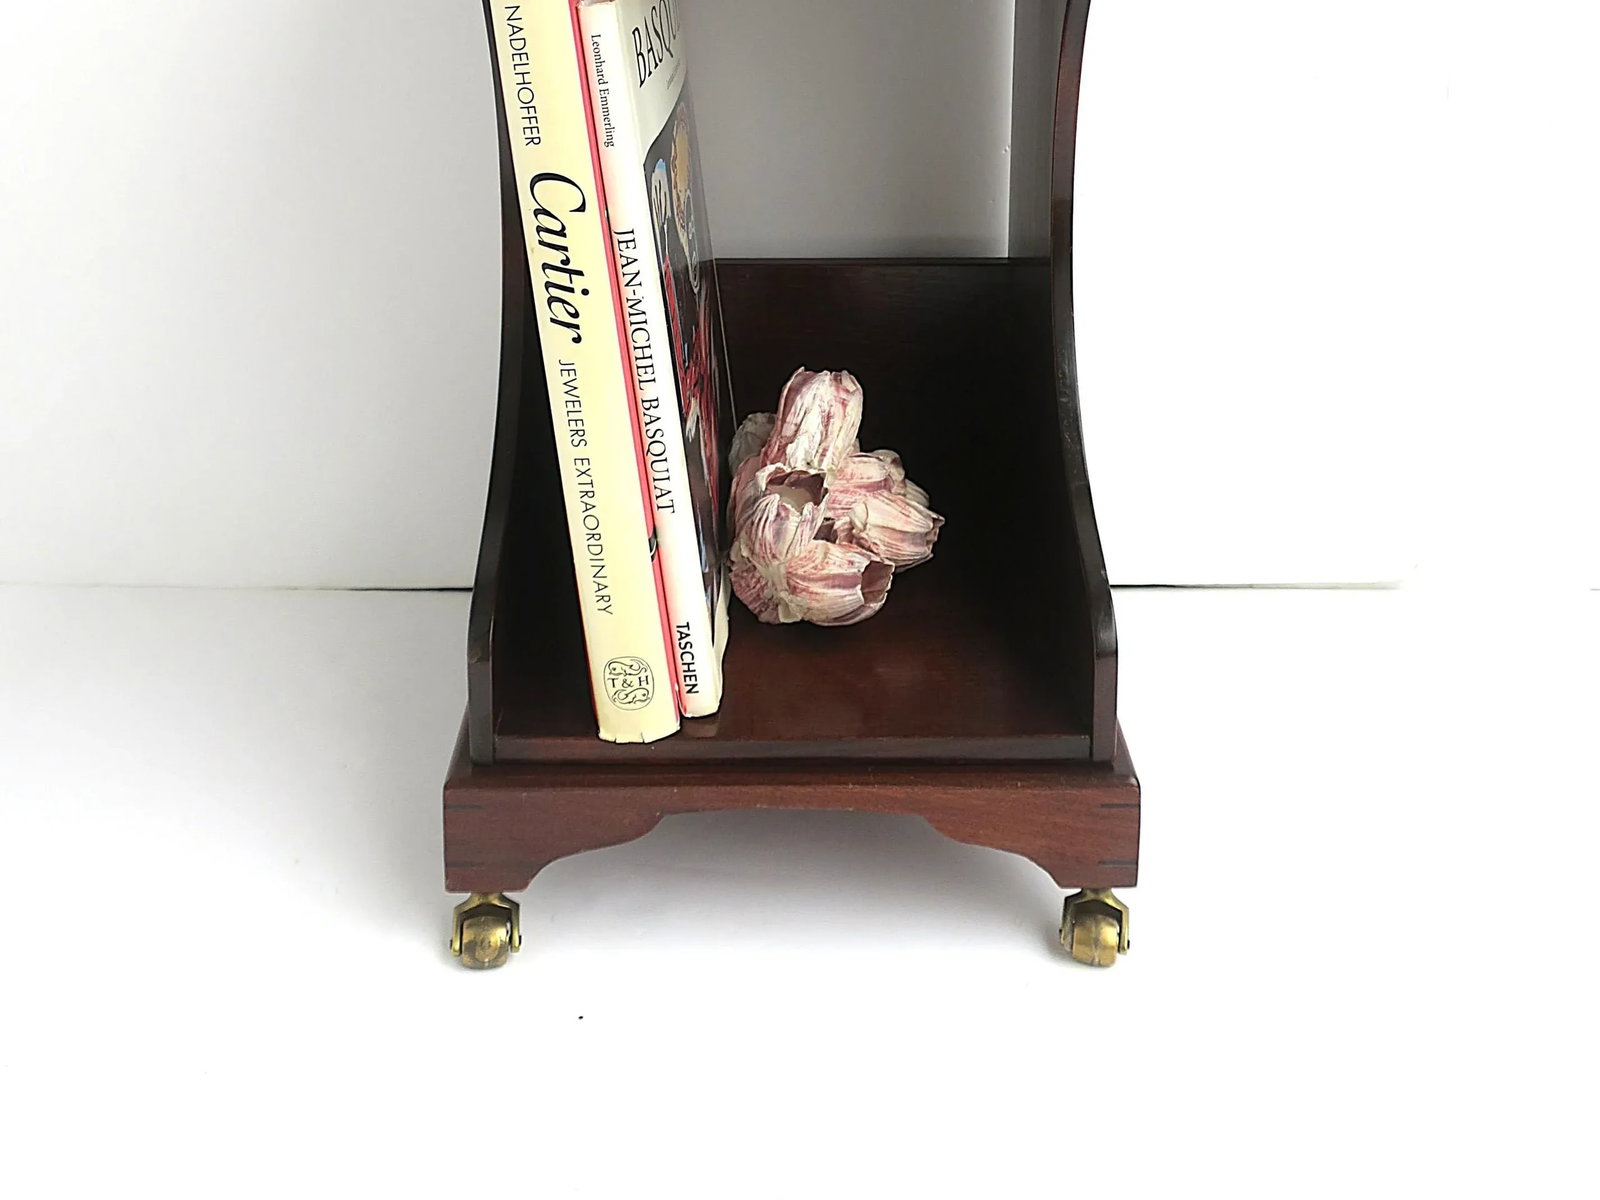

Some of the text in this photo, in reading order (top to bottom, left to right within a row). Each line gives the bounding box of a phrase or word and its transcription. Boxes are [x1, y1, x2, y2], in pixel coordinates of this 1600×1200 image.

[505, 5, 541, 146] NADELHOFFER
[591, 34, 615, 148] Leonhard Emmerling
[529, 172, 590, 344] Cartier
[614, 228, 675, 514] JEAN-MICHEL BASQUIAT
[559, 359, 613, 615] JEWELERS EXTRAORDINARY
[676, 621, 699, 695] TASCHEN
